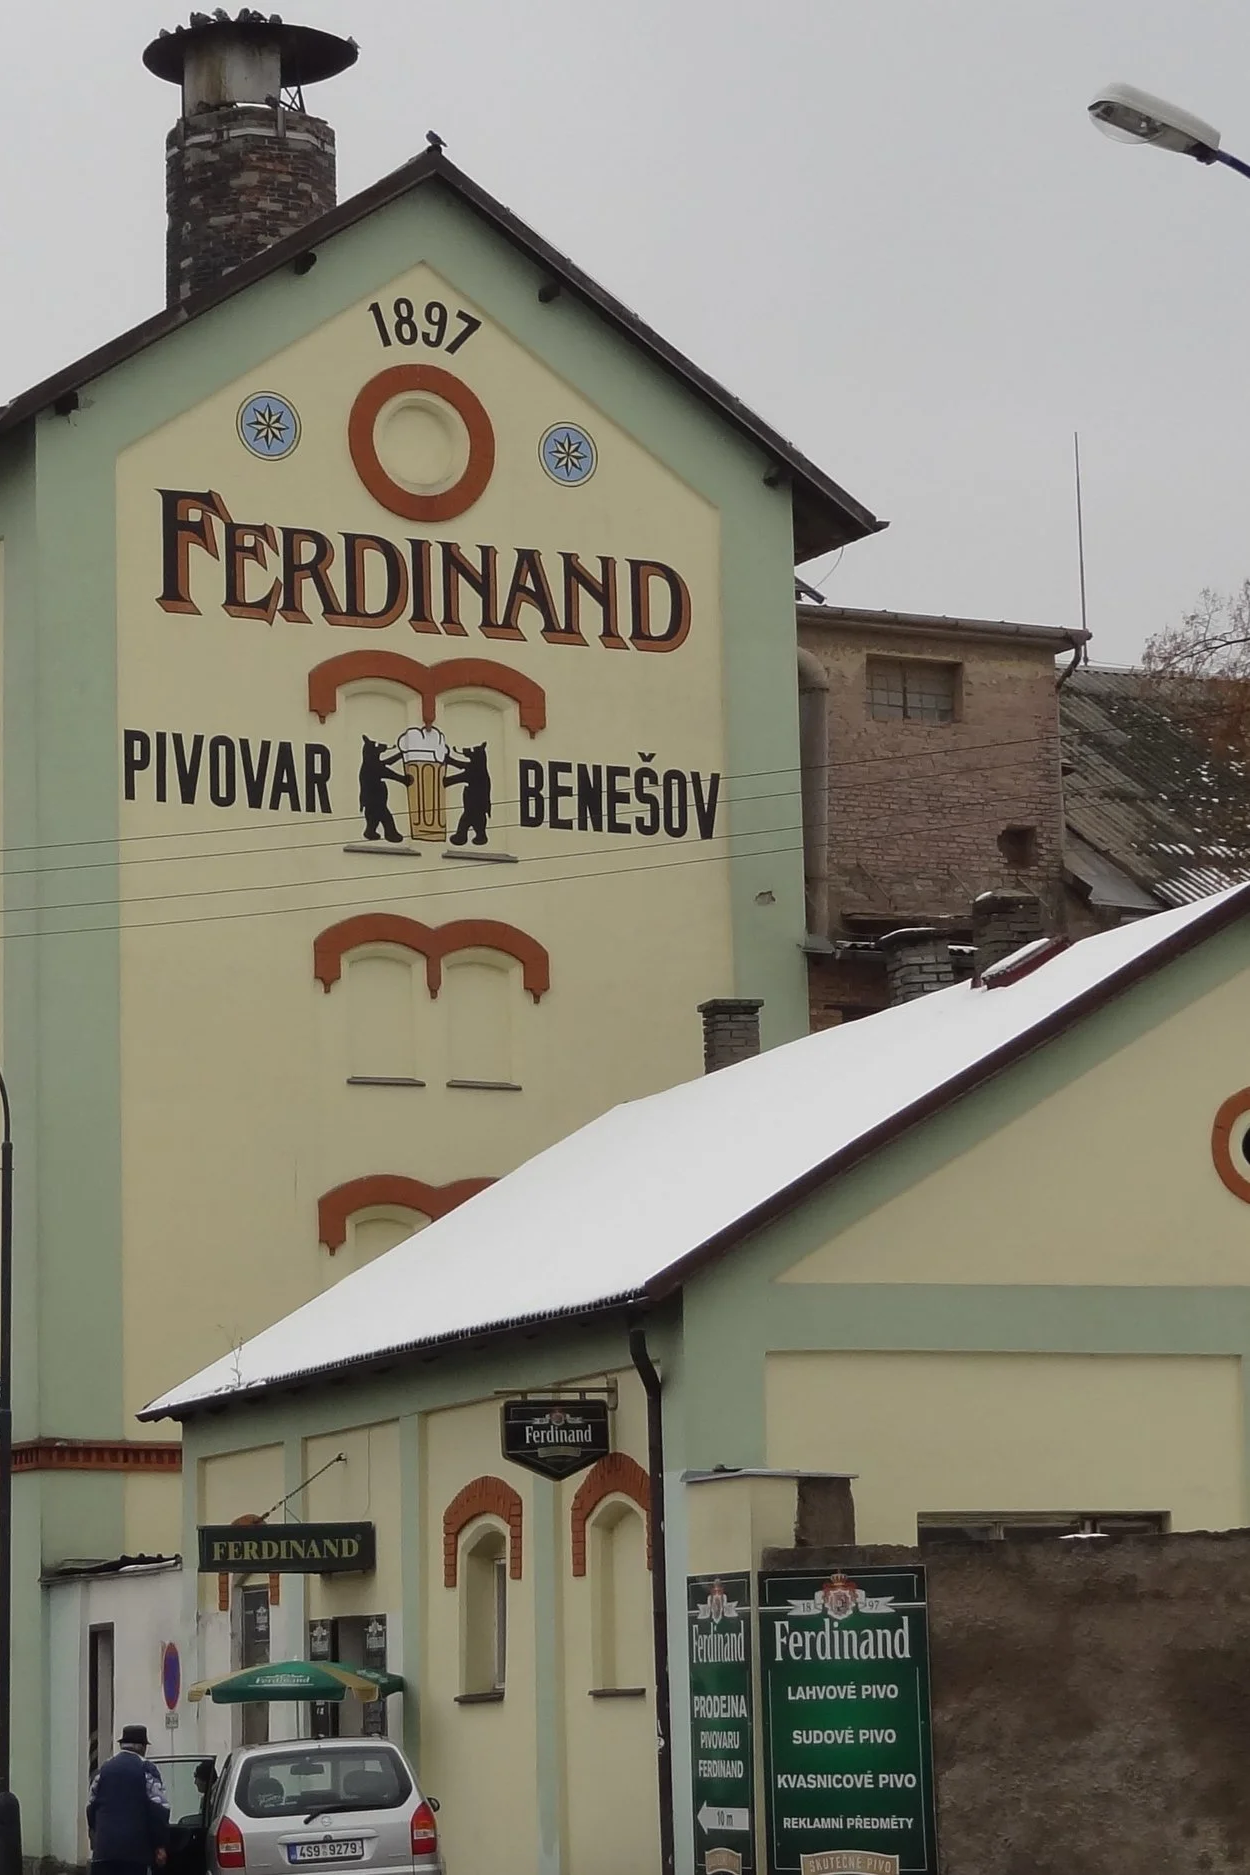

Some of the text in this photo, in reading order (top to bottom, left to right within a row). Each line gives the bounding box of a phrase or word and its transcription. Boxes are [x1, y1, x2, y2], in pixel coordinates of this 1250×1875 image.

[367, 297, 482, 354] 1897
[154, 488, 692, 653] FERDINAND
[124, 729, 332, 814] PIVOVAR
[519, 751, 721, 840] BENEŠOV
[525, 1424, 592, 1444] Ferdinand
[212, 1538, 359, 1561] FERDINAND
[692, 1620, 745, 1663] Ferdinand
[774, 1615, 911, 1662] Ferdinand
[787, 1682, 899, 1701] LAHVOVÉ PIVO
[693, 1695, 748, 1719] PRODEJNA
[700, 1731, 740, 1750] PIVOVARU
[792, 1726, 897, 1745] SUDOVÉ PIVO
[698, 1759, 744, 1779] FERDINAND
[777, 1770, 917, 1789] KVASNICOVÉ PIVO
[717, 1811, 725, 1827] 10
[783, 1814, 914, 1830] REKLAMNÍ PŘEDMĚTY
[299, 1843, 357, 1858] 4S9 9279
[867, 1857, 892, 1873] PIVO
